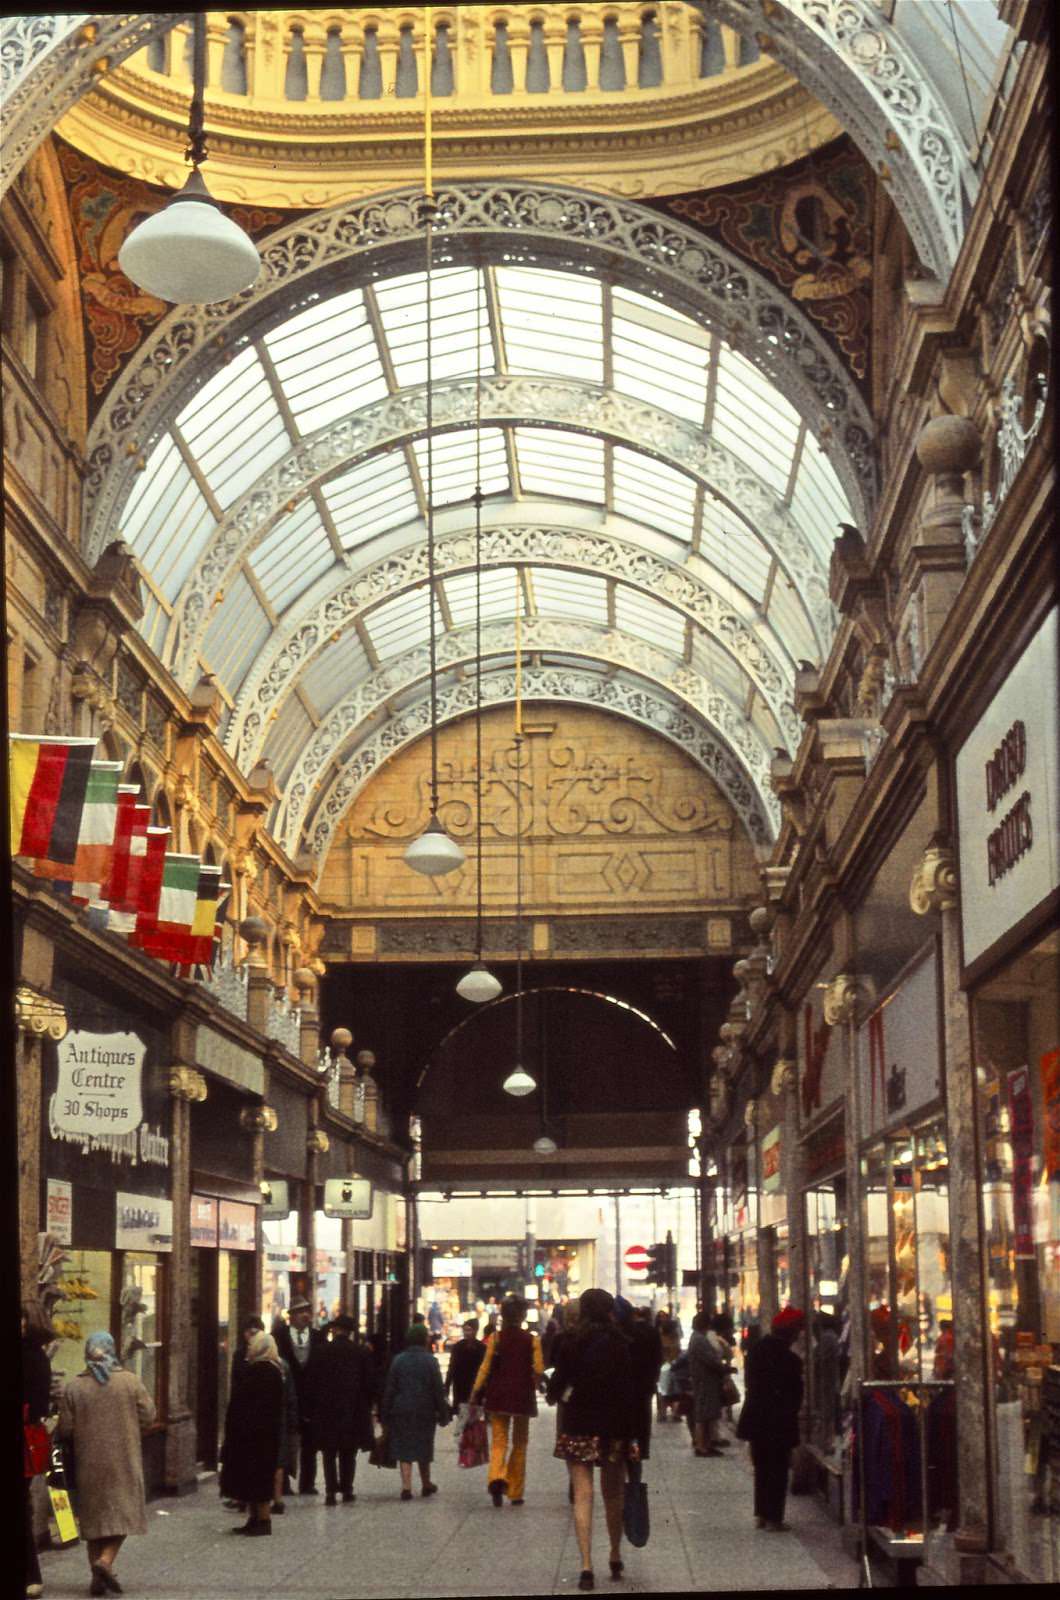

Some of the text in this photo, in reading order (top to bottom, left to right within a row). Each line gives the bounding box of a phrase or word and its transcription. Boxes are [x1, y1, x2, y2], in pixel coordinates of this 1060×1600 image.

[66, 1043, 135, 1067] Antiques
[71, 1067, 126, 1088] Centre
[64, 1100, 129, 1121] 30 Shops
